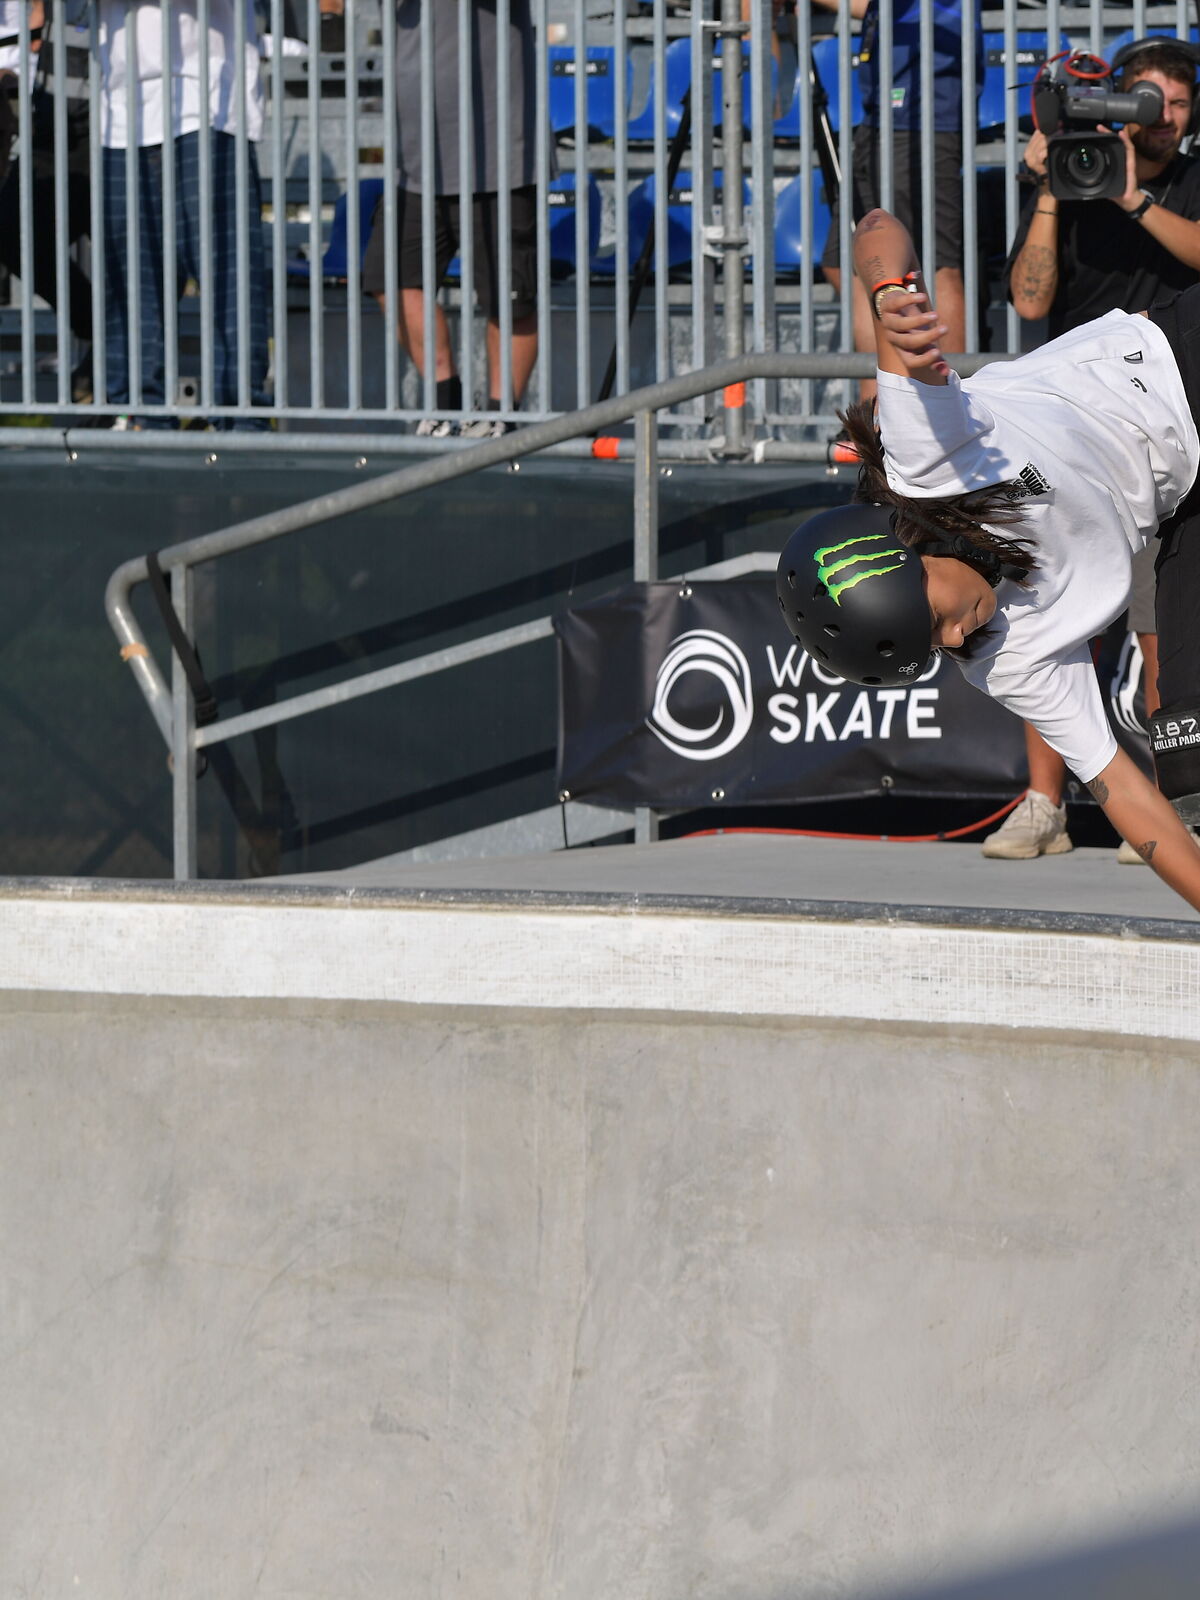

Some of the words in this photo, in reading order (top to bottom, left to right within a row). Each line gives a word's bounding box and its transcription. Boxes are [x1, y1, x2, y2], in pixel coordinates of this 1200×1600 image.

[767, 687, 943, 744] SKATE
[1154, 717, 1198, 739] 187
[1153, 737, 1179, 751] KILLER
